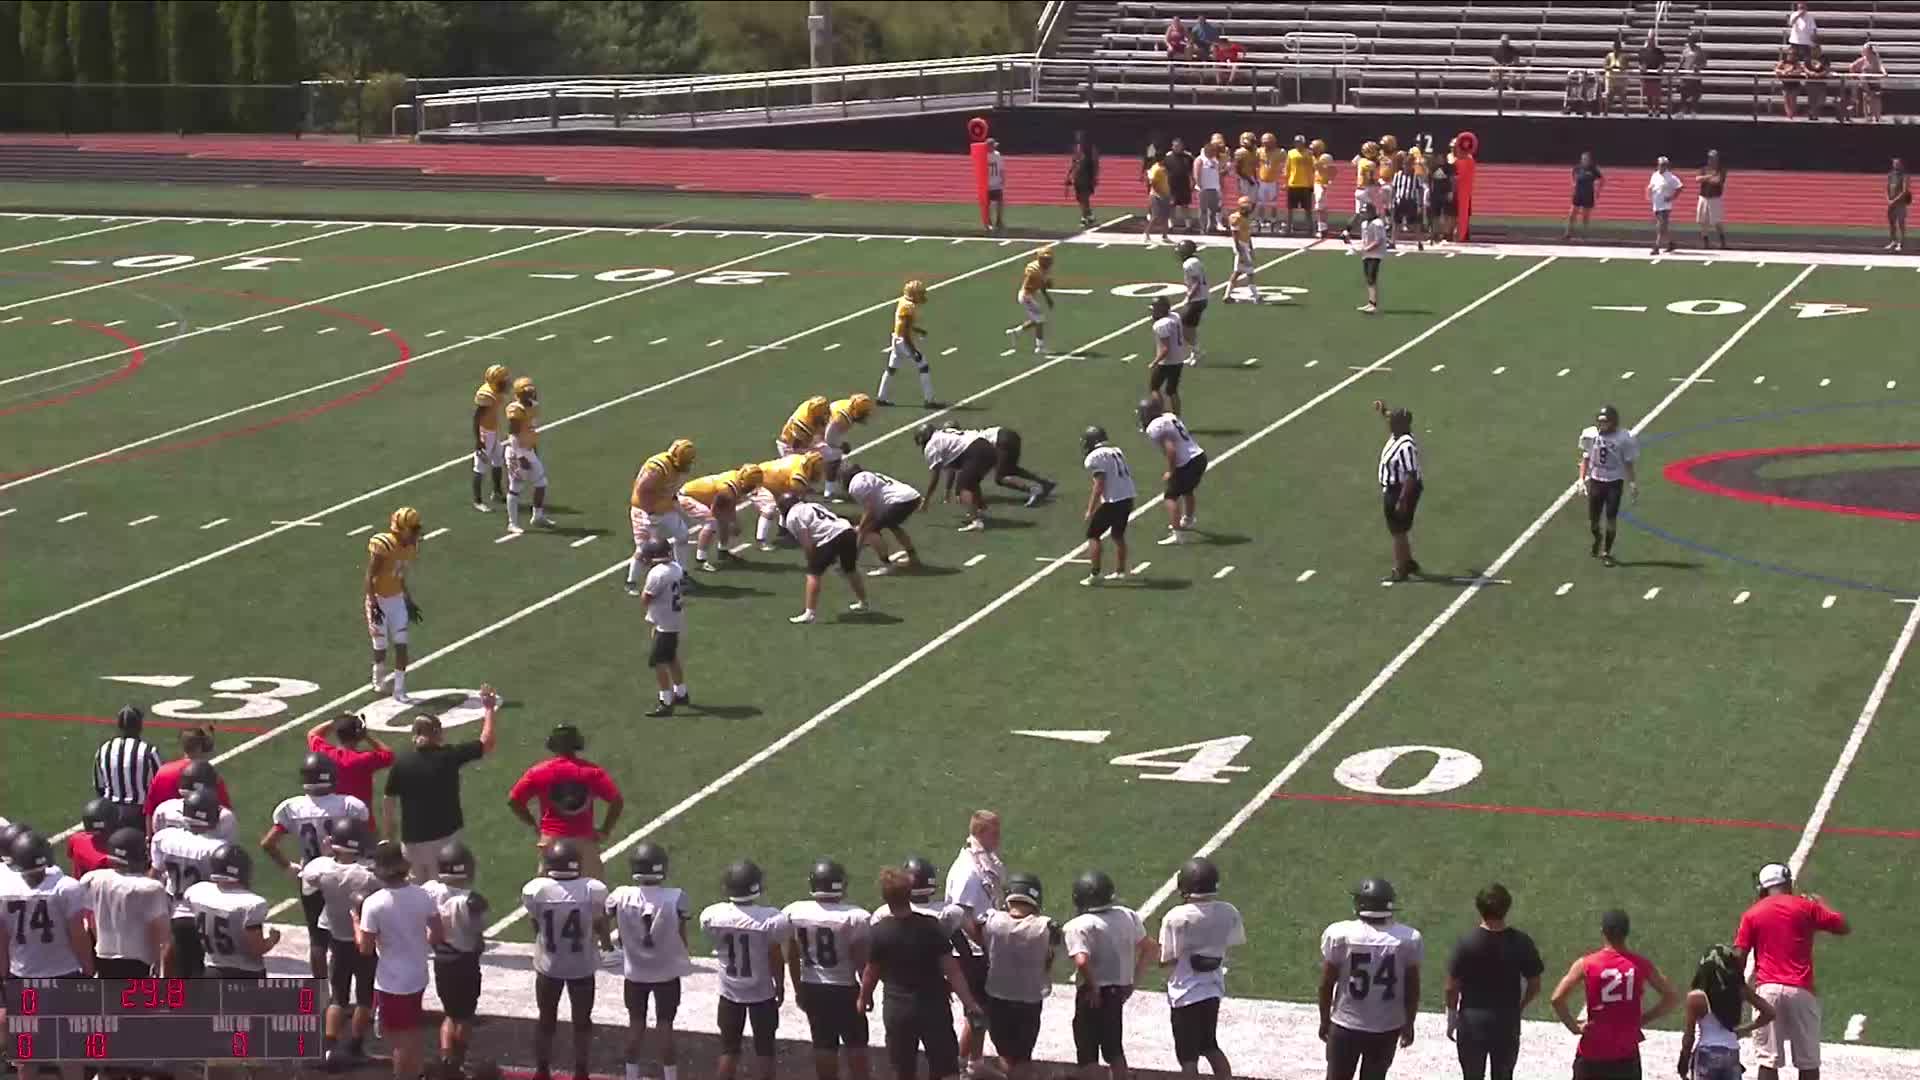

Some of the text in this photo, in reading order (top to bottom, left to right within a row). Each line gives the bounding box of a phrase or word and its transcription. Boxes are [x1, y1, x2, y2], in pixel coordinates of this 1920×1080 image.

[8, 899, 55, 945] 74
[542, 909, 583, 952] 14
[1348, 953, 1398, 1000] 54
[1600, 968, 1636, 1003] 21
